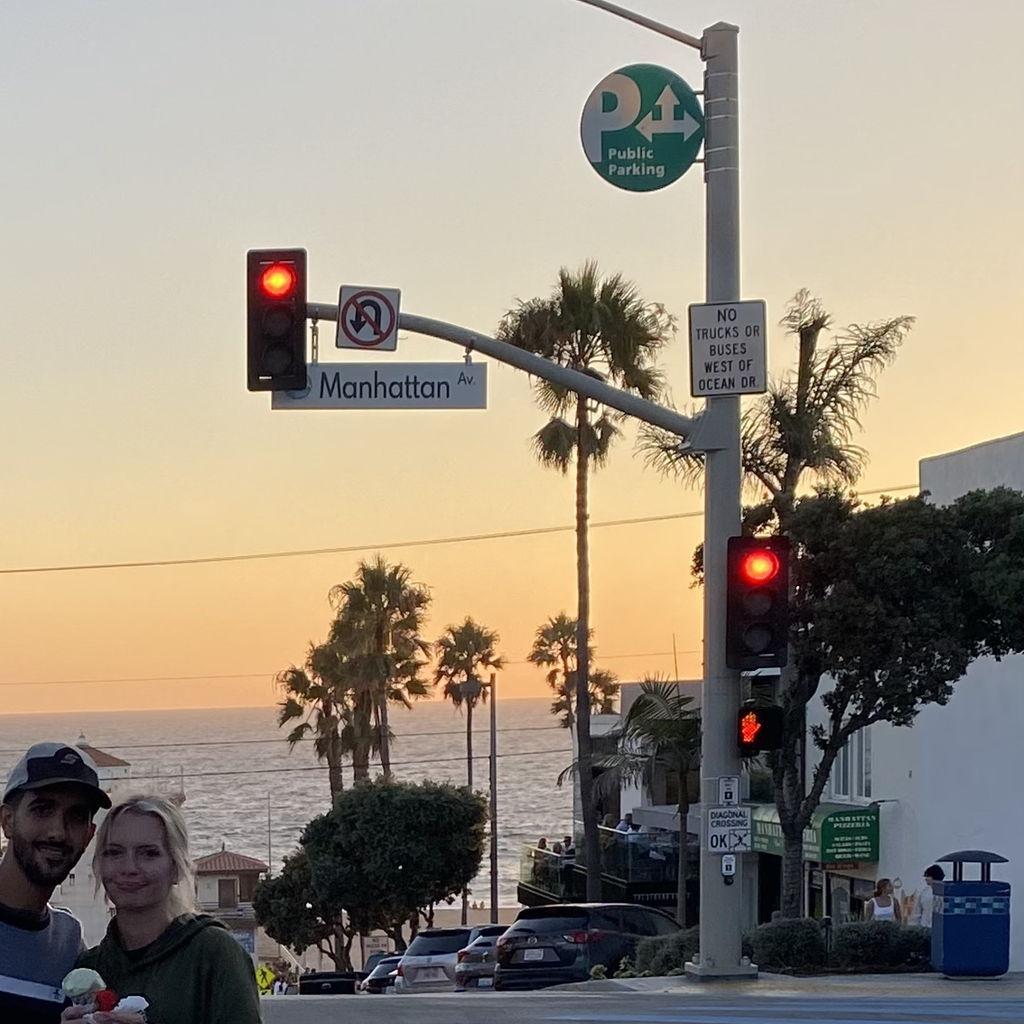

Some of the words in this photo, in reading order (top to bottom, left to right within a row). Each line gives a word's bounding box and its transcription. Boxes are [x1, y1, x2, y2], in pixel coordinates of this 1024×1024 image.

[608, 146, 654, 160] Public
[608, 163, 665, 178] Parking
[717, 308, 737, 322] NO
[696, 326, 740, 340] TRUCKS
[745, 325, 760, 337] OR
[709, 343, 747, 357] BUSES
[704, 360, 733, 373] WEST
[738, 359, 753, 372] OF
[319, 371, 450, 399] Manhattan
[698, 377, 735, 391] OCEAN
[710, 810, 748, 819] DIAGONAL
[710, 819, 748, 828] CROSSING
[710, 834, 727, 848] OK
